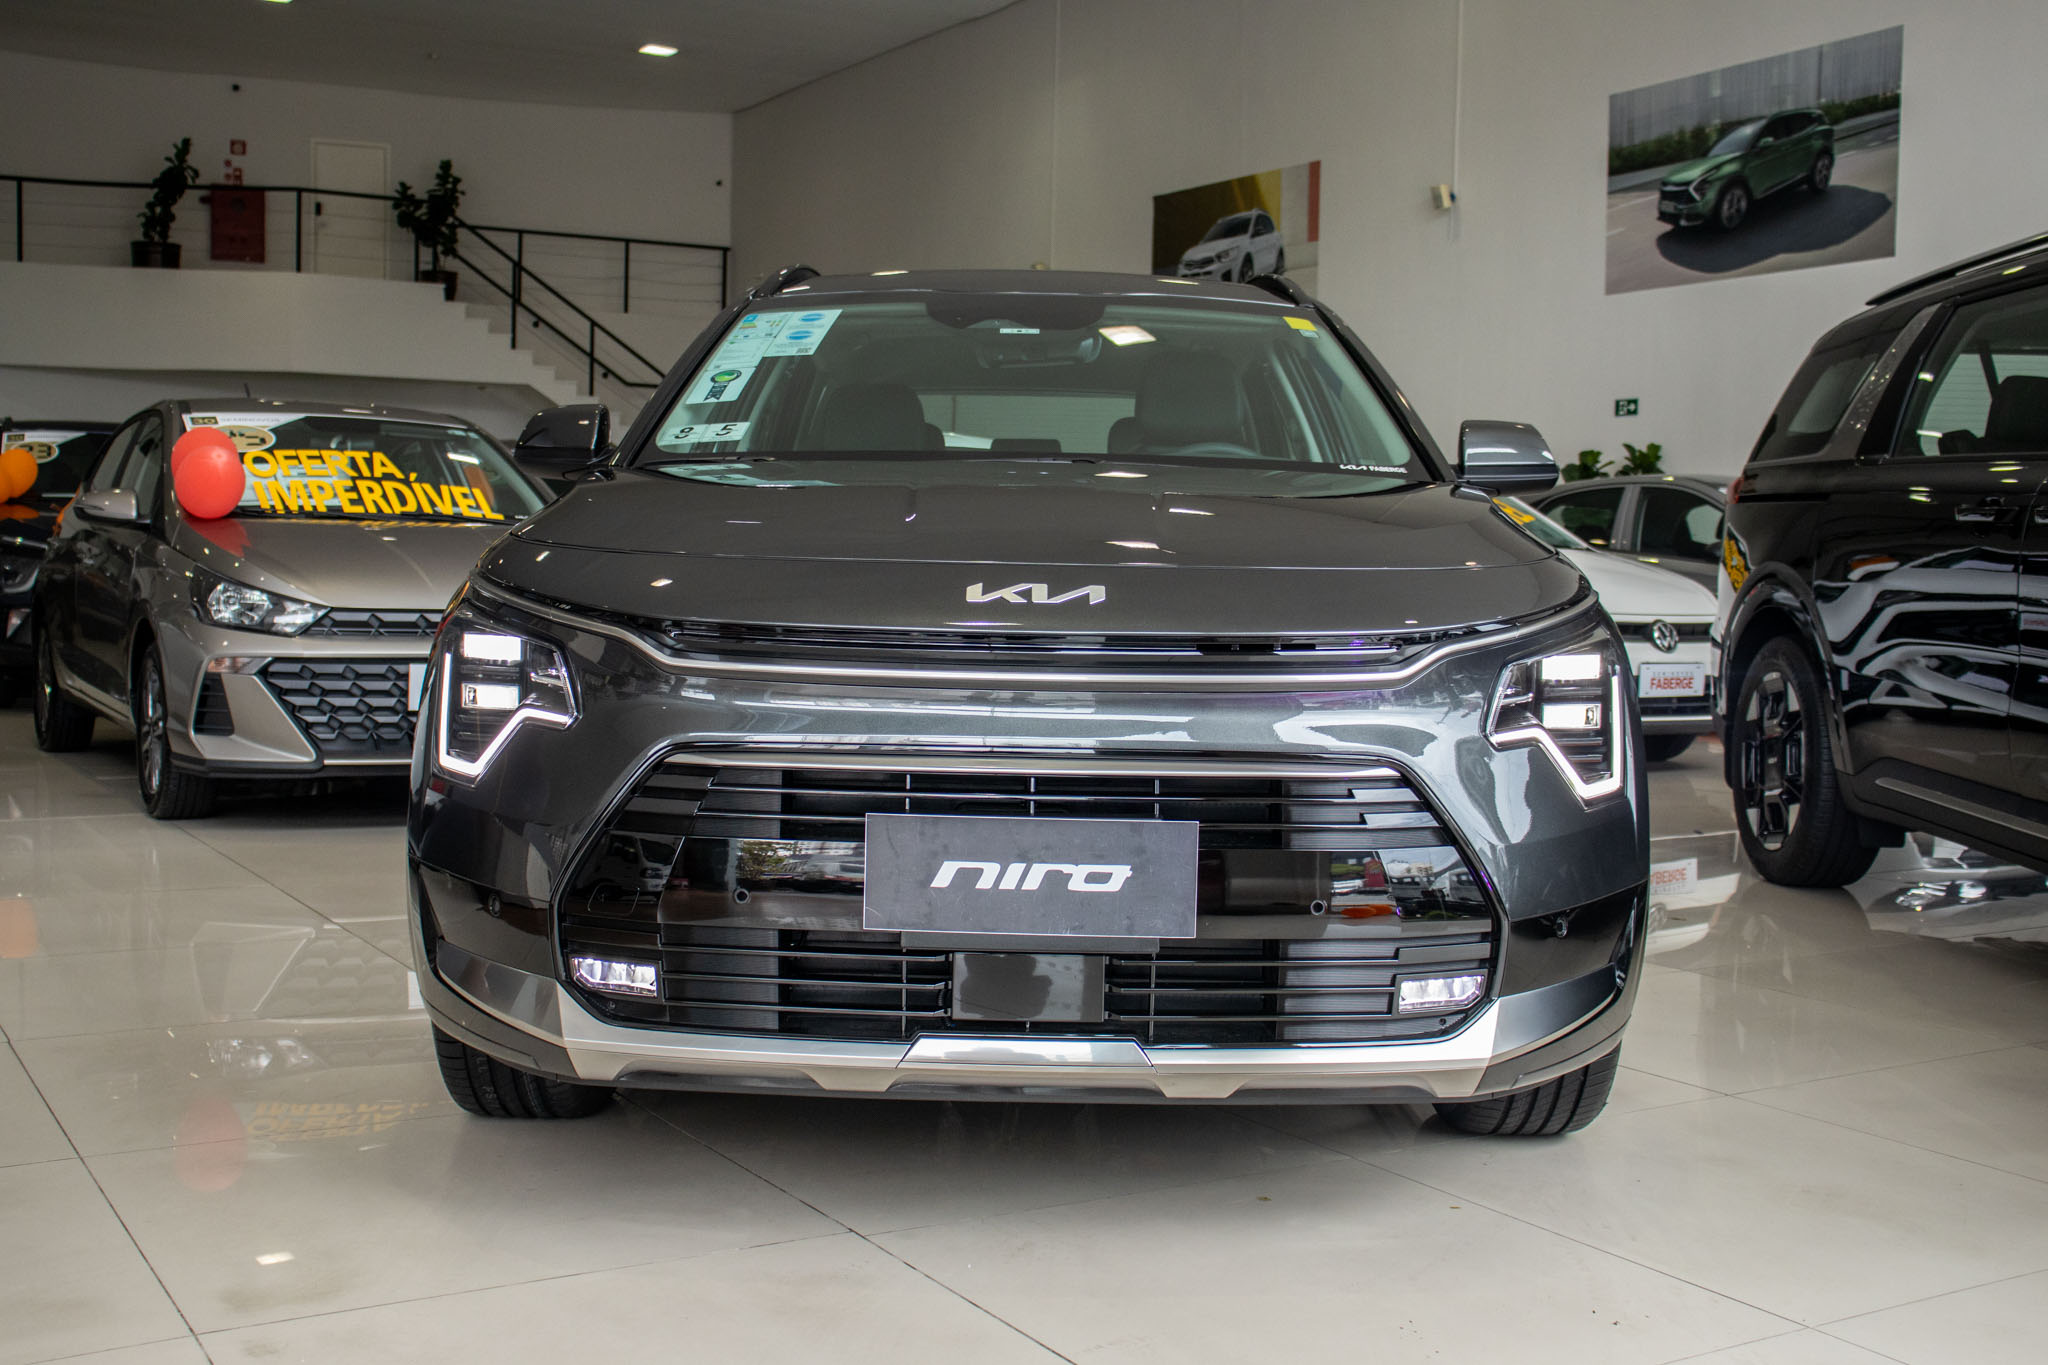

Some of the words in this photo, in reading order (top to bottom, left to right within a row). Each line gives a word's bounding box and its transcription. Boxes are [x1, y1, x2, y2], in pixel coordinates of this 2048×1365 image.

[715, 424, 738, 436] 5
[243, 449, 405, 479] OFERTA
[253, 472, 504, 520] IMPERDÍVEL
[966, 582, 1106, 605] KIA
[1650, 677, 1694, 690] FABERGE
[930, 860, 1132, 892] niro
